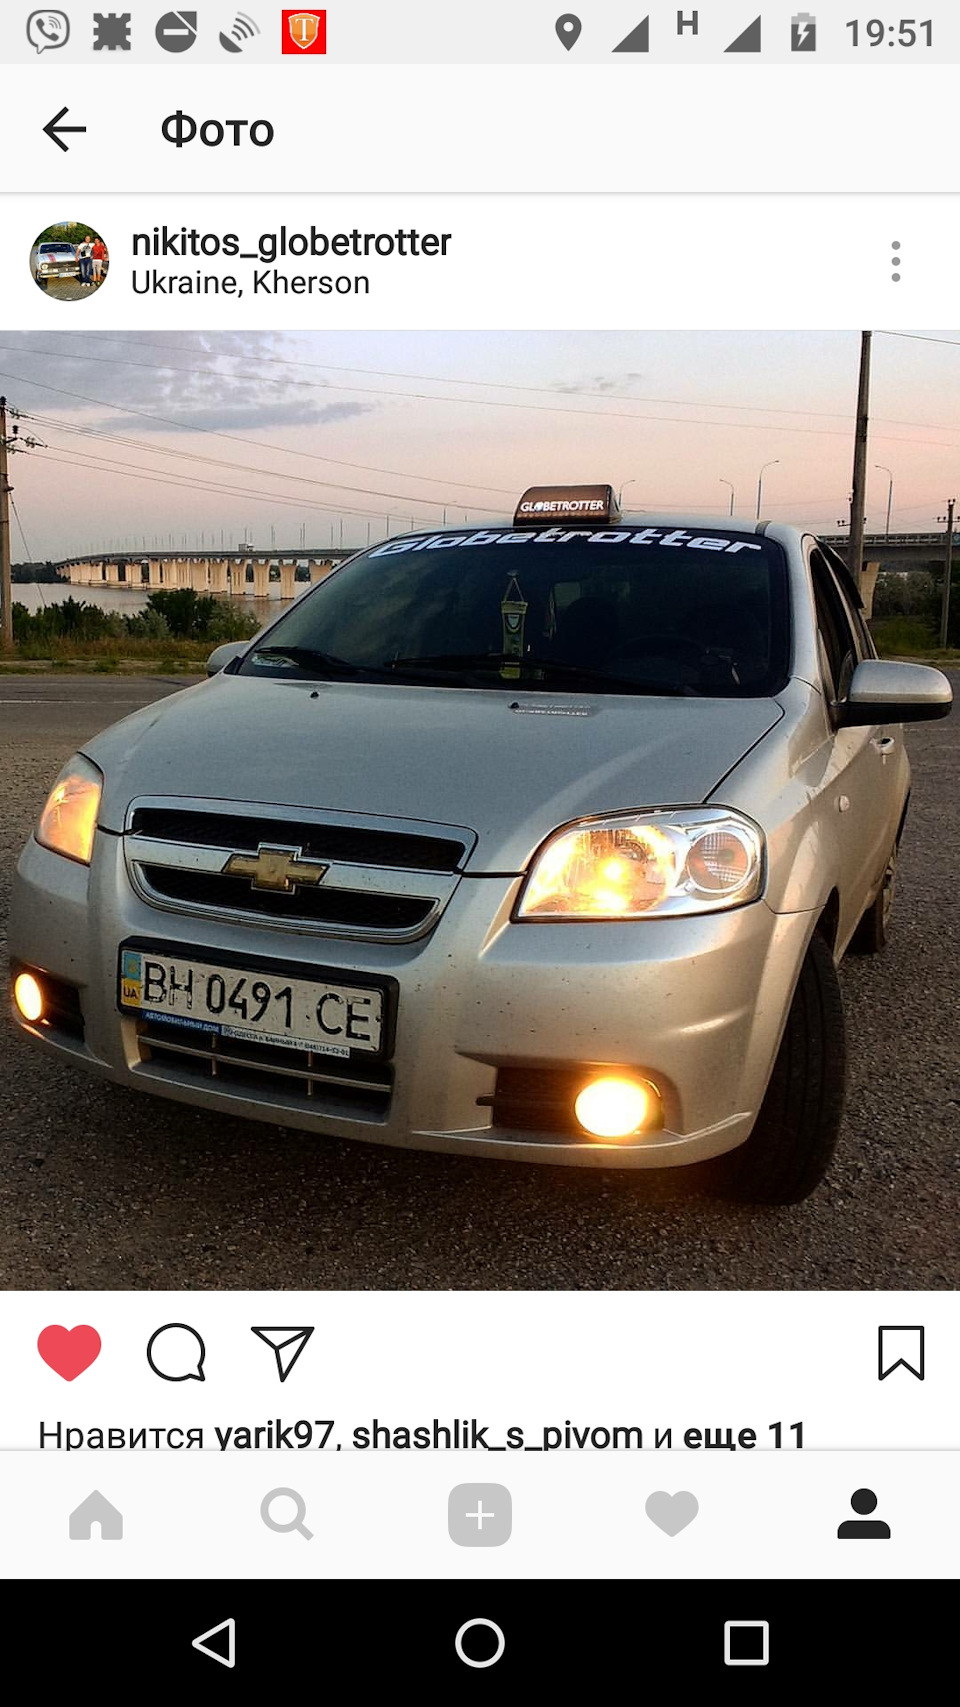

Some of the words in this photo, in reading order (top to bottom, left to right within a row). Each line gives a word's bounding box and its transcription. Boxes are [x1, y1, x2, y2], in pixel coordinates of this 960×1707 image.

[846, 18, 936, 47] 19:51
[162, 110, 274, 149] Фото
[132, 226, 452, 263] nikitos_globetrotter
[132, 269, 244, 298] Ukraine,
[253, 269, 370, 295] Kherson
[520, 500, 604, 513] GLOBETROTTER
[368, 527, 762, 558] Globetrotter
[123, 984, 138, 999] UA
[144, 961, 194, 1009] BH
[205, 973, 293, 1029] 0491
[316, 993, 371, 1041] CE
[39, 1421, 204, 1449] Нравится
[213, 1419, 342, 1449] yarik97,
[352, 1419, 643, 1449] shashlik_s_pivom
[655, 1427, 672, 1449] и
[683, 1427, 757, 1449] еще
[768, 1422, 804, 1448] 11
